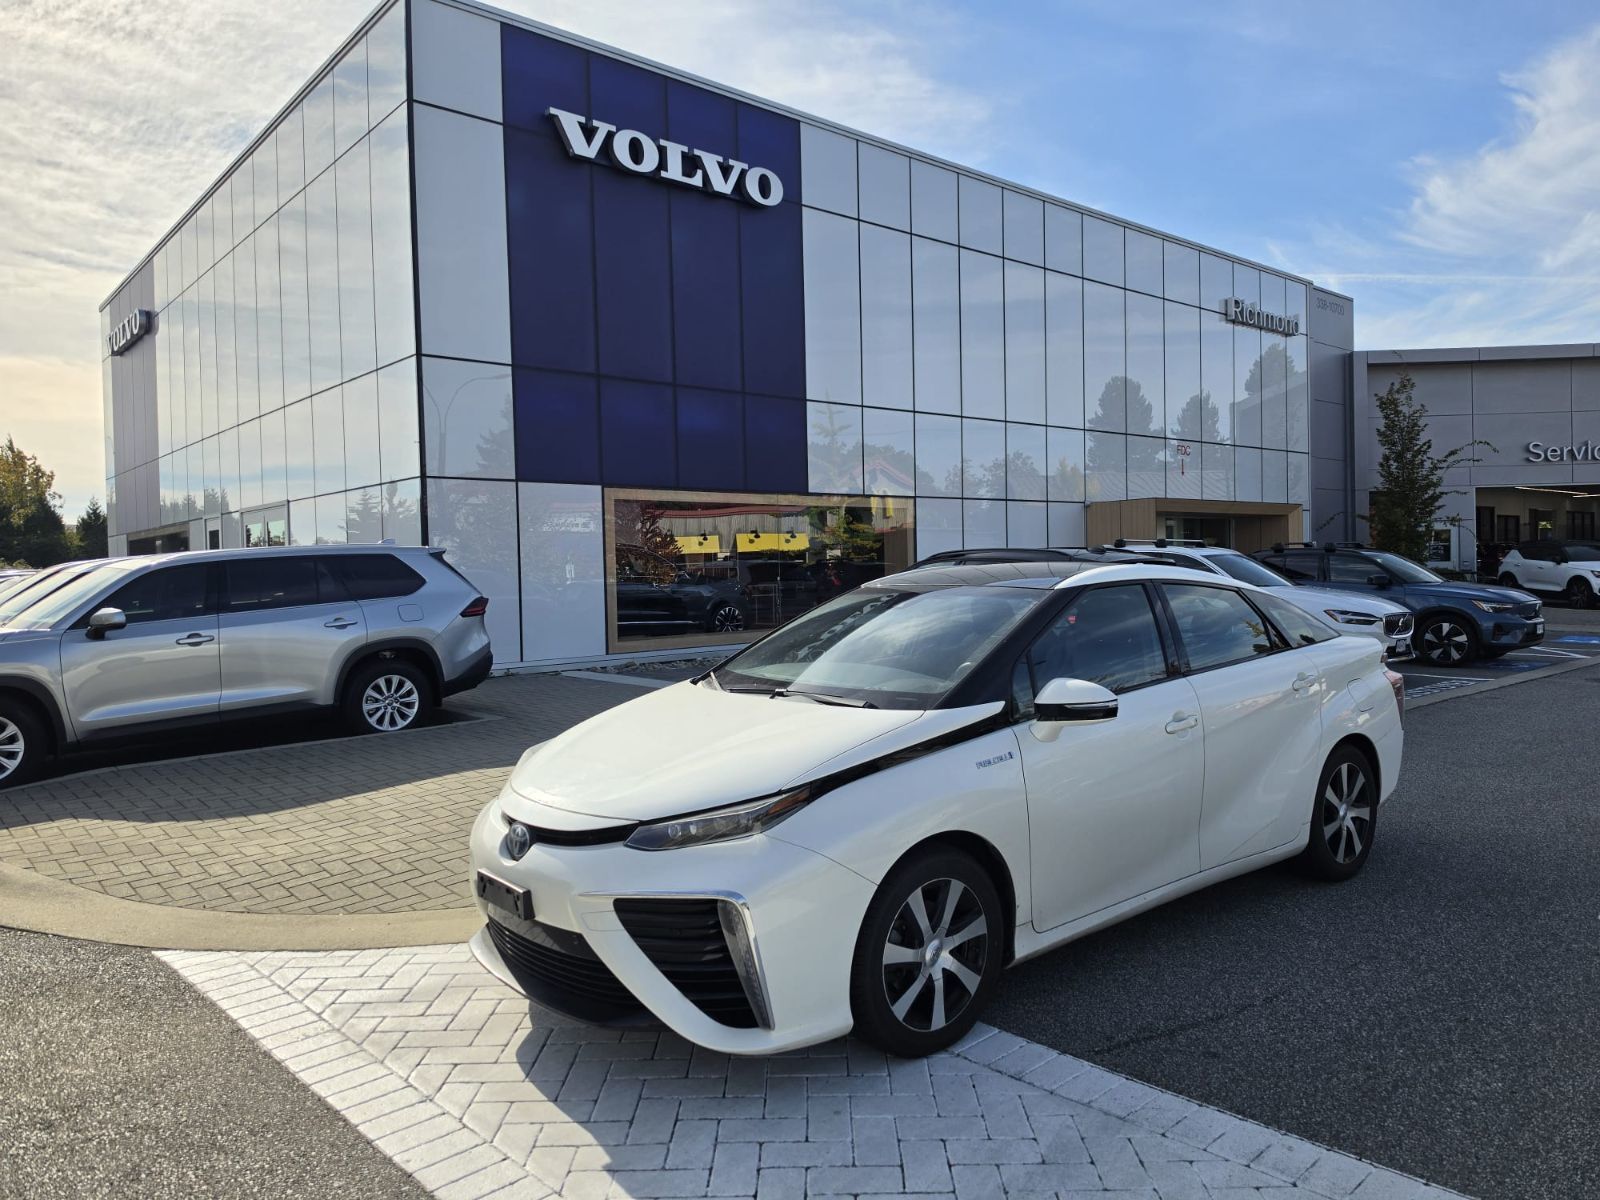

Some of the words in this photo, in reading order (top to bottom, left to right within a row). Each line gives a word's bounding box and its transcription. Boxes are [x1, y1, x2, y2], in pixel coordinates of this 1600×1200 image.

[547, 106, 784, 207] VOLVO
[106, 308, 140, 355] VOLVO
[1228, 297, 1300, 335] Richmond
